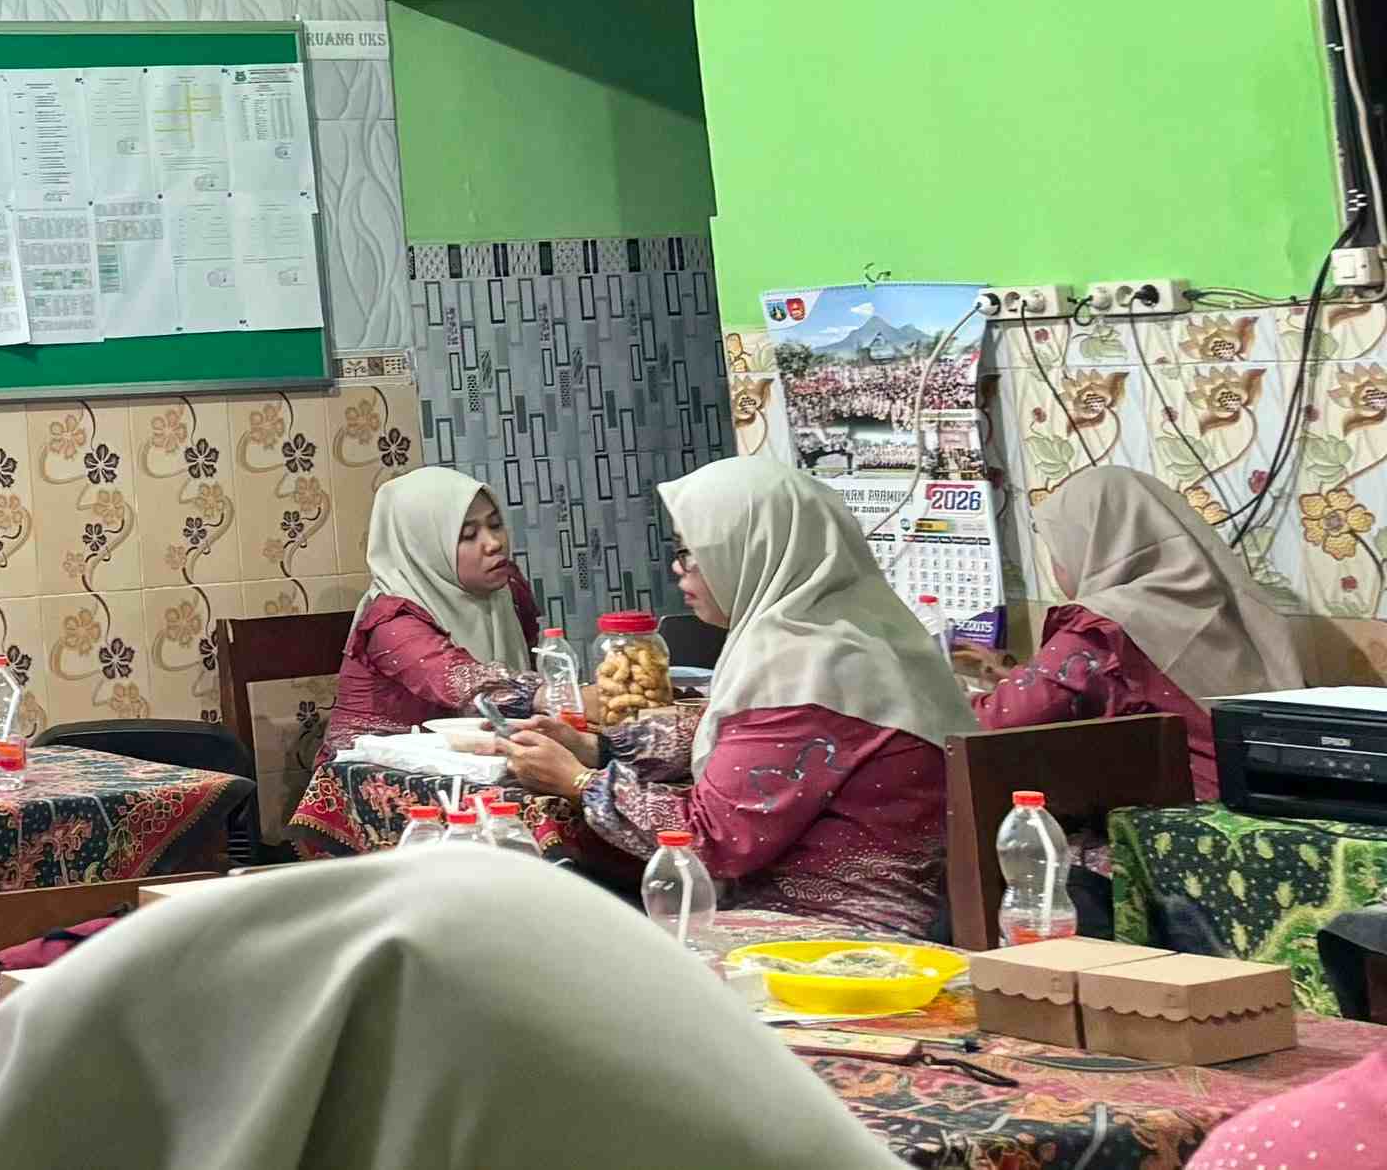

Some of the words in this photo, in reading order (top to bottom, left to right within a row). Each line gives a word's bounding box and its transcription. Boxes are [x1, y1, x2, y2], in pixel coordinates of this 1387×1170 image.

[307, 33, 354, 46] RUANG
[359, 33, 386, 46] UKS
[931, 491, 981, 510] 2026
